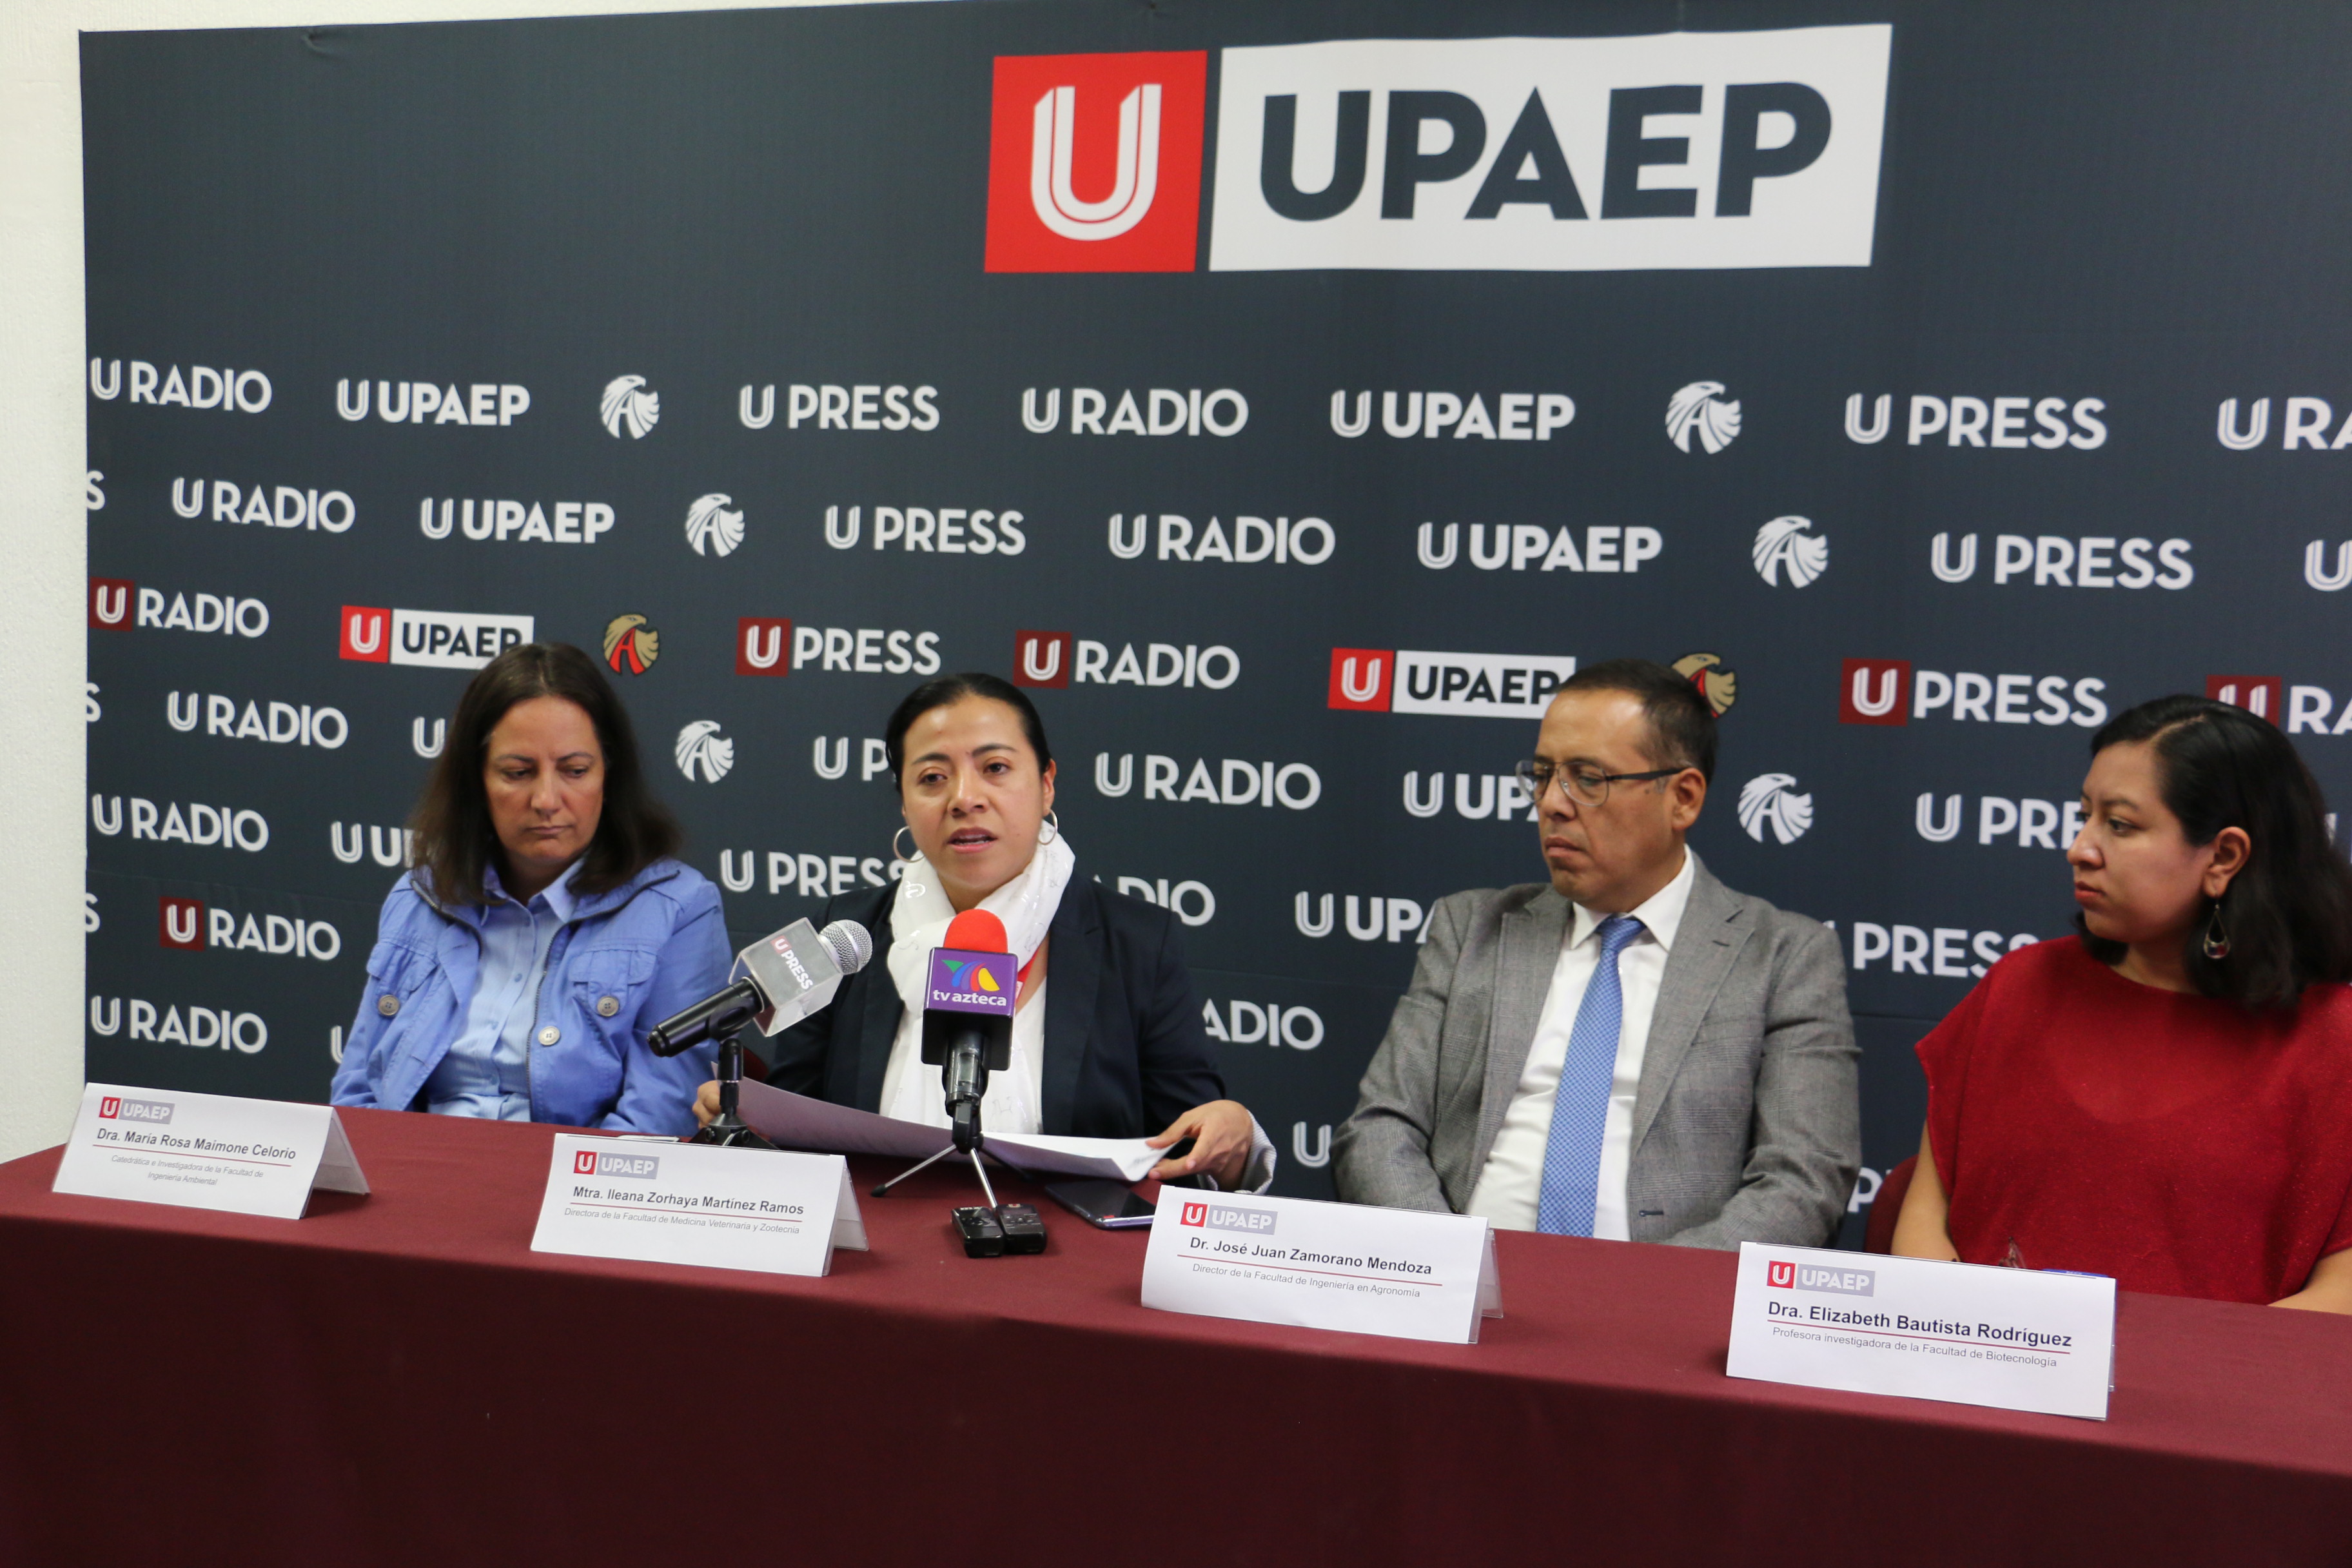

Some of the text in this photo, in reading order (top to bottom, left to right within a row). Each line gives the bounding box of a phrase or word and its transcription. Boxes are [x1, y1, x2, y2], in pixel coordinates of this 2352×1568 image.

[1031, 81, 1832, 240] U UPAEP
[90, 357, 272, 413] U RADIO
[337, 378, 531, 426] U UPAEP
[739, 384, 940, 431] U PRESS
[1022, 387, 1249, 436] U RADIO
[1330, 389, 1575, 440] U UPAEP
[1845, 393, 2107, 450] U PRESS
[2217, 397, 2270, 451] U
[172, 477, 356, 533] U RADIO
[420, 497, 615, 544] U UPAEP
[825, 505, 1026, 556] U PRESS
[1108, 513, 1336, 565] U RADIO
[1417, 522, 1662, 573] U UPAEP
[1931, 532, 2193, 590] U PRESS
[97, 585, 270, 638] U RADIO
[349, 614, 523, 658] U UPAEP
[746, 625, 941, 676] U PRESS
[1024, 638, 1240, 689] U RADIO
[1342, 657, 1560, 705] U UPAEP
[167, 691, 348, 749] U RADIO
[1852, 667, 2107, 727] U PRESS
[413, 716, 446, 759] U
[813, 736, 849, 779] U
[1095, 752, 1321, 810] U RADIO
[1404, 770, 1540, 822] U UP
[92, 794, 269, 852] U RADIO
[1916, 792, 1961, 842] U
[331, 821, 363, 863] U
[720, 848, 754, 892] U
[167, 905, 340, 961] U RADIO
[1295, 891, 1334, 937] U
[775, 938, 814, 990] U PRESS
[933, 989, 1007, 1006] tv azteca
[91, 995, 268, 1054] U RADIO
[103, 1099, 170, 1120] U UPAEP
[97, 1128, 296, 1159] Dra. María Rosa Maimone Celorio
[112, 1155, 150, 1166] Catedrática
[157, 1159, 202, 1171] Investigadora
[204, 1164, 214, 1173] de
[224, 1166, 253, 1176] Facultad
[578, 1154, 655, 1175] U UPAEP
[1293, 1121, 1331, 1167] U
[182, 1175, 218, 1186] Ambiental
[573, 1186, 804, 1215] Mtra. Ileana Zorhaya Martínez Ramos
[565, 1208, 600, 1217] Directora
[623, 1213, 657, 1222] Facultad
[671, 1216, 706, 1226] Medicina
[709, 1219, 750, 1230] Veterinaria
[760, 1223, 799, 1234] Zootecnia
[1186, 1206, 1272, 1230] U UPAEP
[1190, 1237, 1432, 1275] Dr. José Juan Zamorano Mendoza
[1193, 1263, 1228, 1275] Director
[1230, 1268, 1242, 1277] de
[1244, 1269, 1251, 1279] la
[1254, 1271, 1293, 1284] Facultad
[1295, 1276, 1307, 1285] de
[1309, 1277, 1355, 1290] Ingeniería
[1772, 1264, 1870, 1290] U UPAEP
[1769, 1301, 2072, 1347] Dra. Elizabeth Bautista Rodríguez
[1772, 1326, 2057, 1367] Profesora investigadora de la Facultad de Biotecnología
